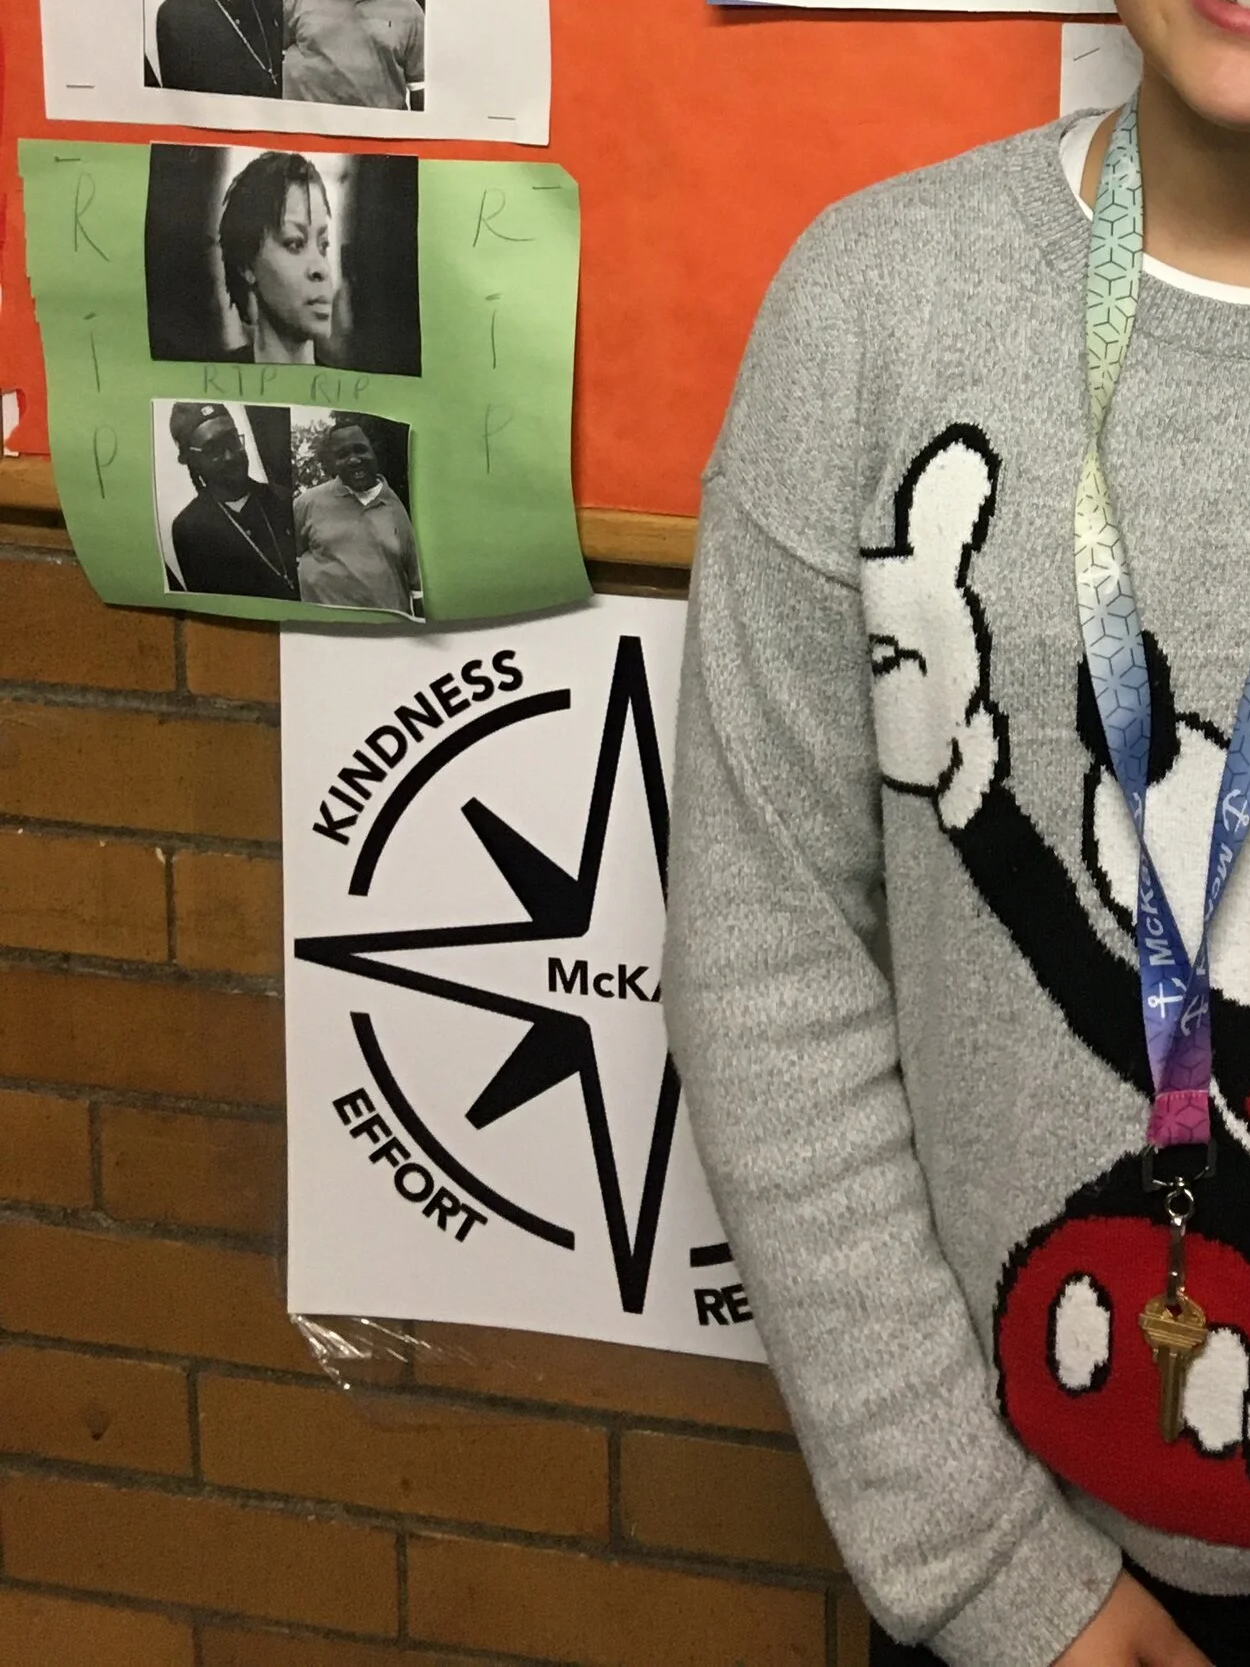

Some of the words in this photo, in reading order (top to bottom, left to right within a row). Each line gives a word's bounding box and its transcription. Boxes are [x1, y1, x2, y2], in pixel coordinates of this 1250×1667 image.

[311, 648, 525, 847] KINDNESS
[546, 956, 663, 1003] McK
[331, 1086, 489, 1244] EFFORT
